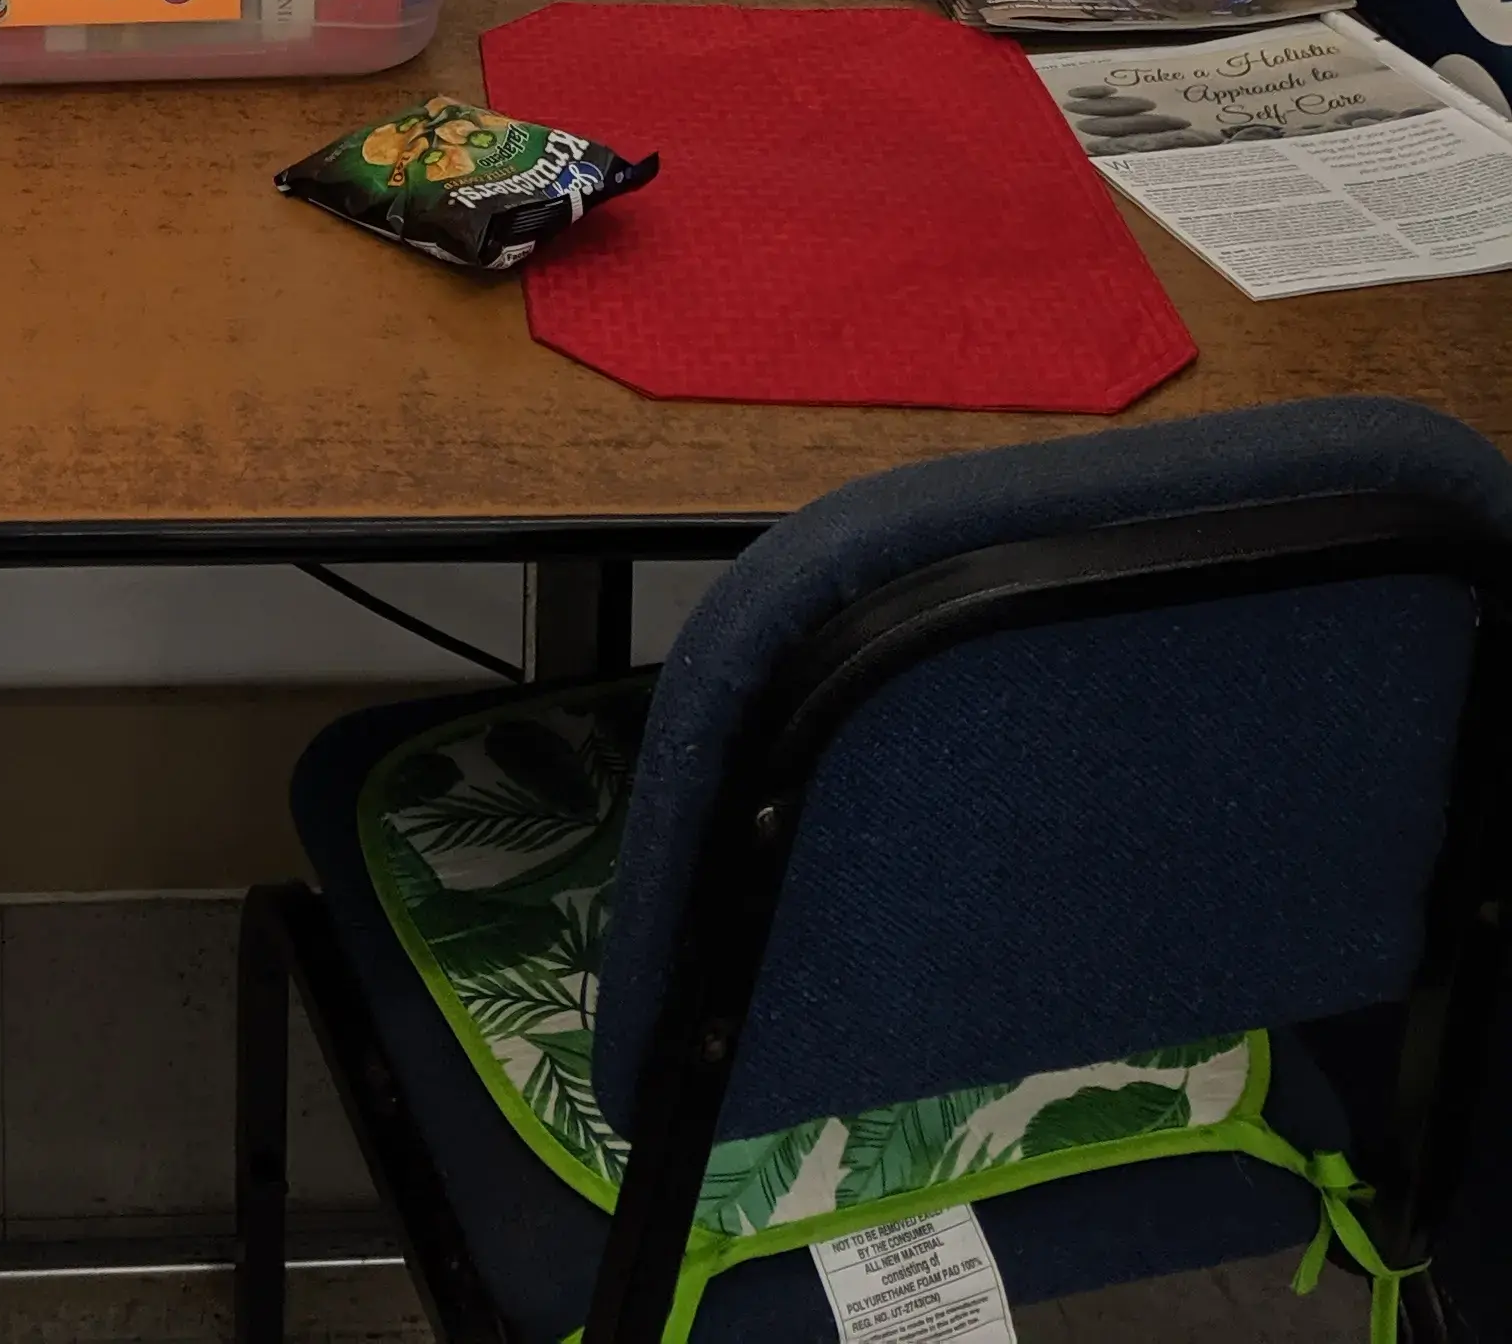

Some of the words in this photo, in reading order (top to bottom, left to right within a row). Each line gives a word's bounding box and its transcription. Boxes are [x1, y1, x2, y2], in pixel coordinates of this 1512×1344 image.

[1105, 68, 1185, 86] Take
[1194, 69, 1209, 78] a
[1217, 44, 1339, 78] Holistic
[1176, 74, 1307, 105] Approach
[1312, 68, 1338, 82] to
[1217, 93, 1366, 126] Self-Care
[448, 129, 589, 208] Krunchers!
[832, 1238, 850, 1252] NOT
[851, 1234, 864, 1246] TO
[865, 1230, 877, 1242] BE
[858, 1248, 870, 1259] BY
[872, 1241, 888, 1254] THE
[888, 1224, 935, 1248] CONSUMER
[865, 1261, 882, 1275] ALL
[883, 1252, 901, 1268] NEW
[901, 1237, 944, 1260] MATERIAL
[881, 1258, 928, 1286] consisting
[930, 1253, 940, 1267] of
[846, 1283, 916, 1314] POLYURETHANE
[917, 1271, 941, 1288] FOAM
[943, 1265, 960, 1280] PAD
